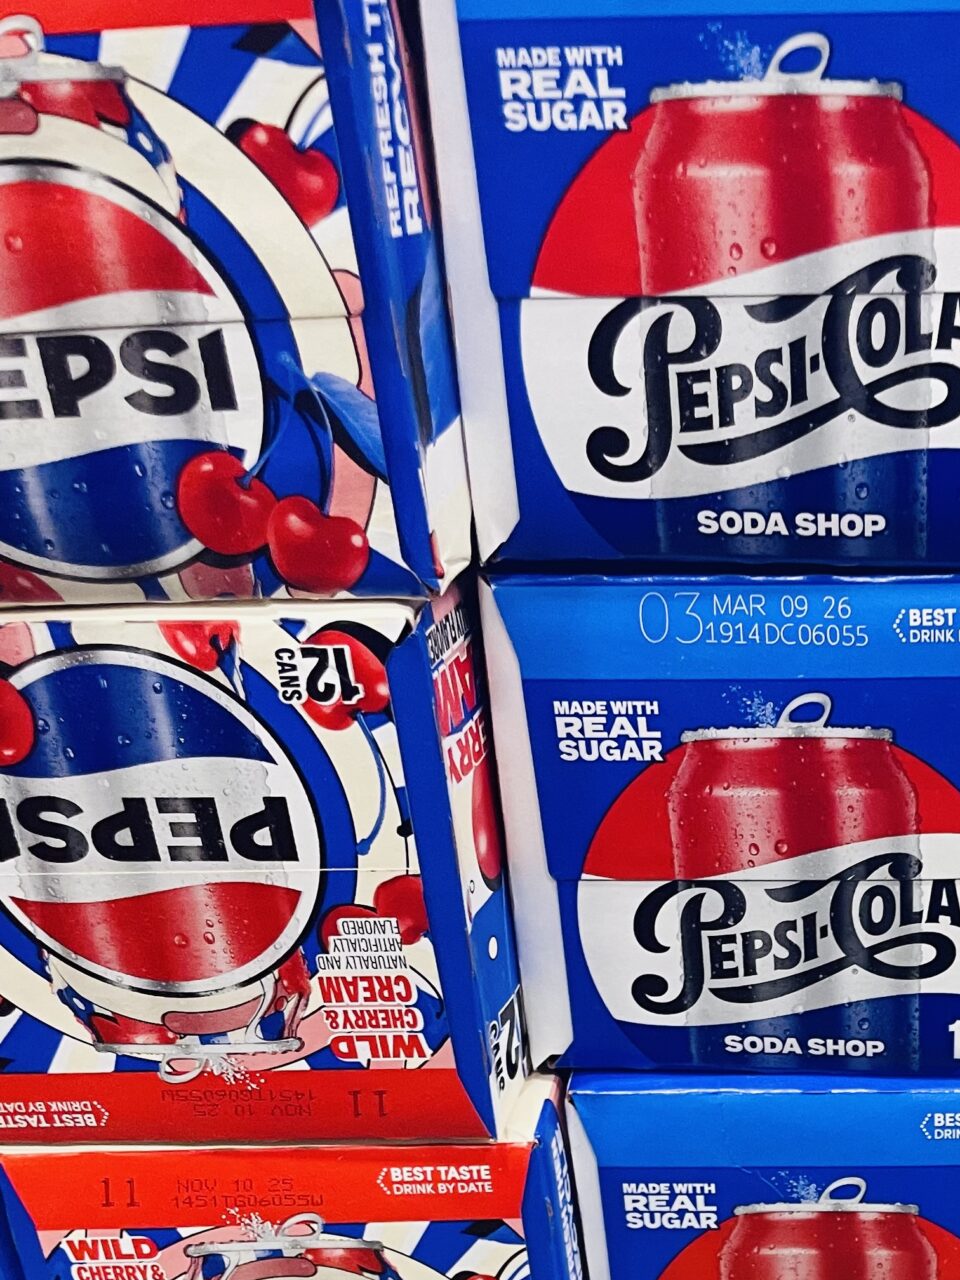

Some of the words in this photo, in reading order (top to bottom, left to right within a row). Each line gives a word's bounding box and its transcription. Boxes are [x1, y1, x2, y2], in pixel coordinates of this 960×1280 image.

[496, 47, 560, 67] MADE
[565, 46, 623, 66] WITH
[499, 69, 626, 99] REAL
[503, 100, 627, 131] SUGAR
[697, 511, 789, 536] SODA
[795, 512, 886, 538] SHOP
[639, 592, 703, 644] 03
[713, 594, 765, 616] MAR
[781, 595, 808, 617] 09
[823, 597, 851, 619] 26
[909, 608, 956, 626] BEST
[909, 628, 955, 643] DRINK
[275, 647, 301, 703] CANS
[304, 646, 362, 703] 12
[554, 701, 607, 716] MADE
[611, 701, 659, 715] WITH
[556, 717, 661, 738] REAL
[559, 739, 664, 762] SUGAR
[342, 920, 399, 934] FLAVORED
[333, 938, 403, 952] ARTIFICIALLY
[318, 956, 340, 970] AND
[345, 956, 407, 969] NATURALLY
[318, 975, 412, 1003] CREAM
[330, 1035, 426, 1059] WILD
[724, 1035, 802, 1054] SODA
[807, 1038, 884, 1056] SHOP
[28, 1102, 46, 1112] BY
[47, 1101, 92, 1111] DRINK
[53, 1114, 97, 1127] BEST
[390, 1167, 435, 1182] BEST
[438, 1166, 491, 1180] TASTE
[100, 1177, 141, 1207] 11
[177, 1179, 217, 1193] NOV
[233, 1178, 254, 1192] 10
[269, 1178, 294, 1191] 25
[393, 1183, 437, 1195] DRINK
[440, 1183, 456, 1195] BY
[458, 1181, 493, 1194] DATE
[622, 1184, 669, 1194] MADE
[673, 1183, 716, 1194] WITH
[624, 1195, 718, 1212] REAL
[626, 1212, 718, 1229] SUGAR
[66, 1239, 159, 1261] WILD
